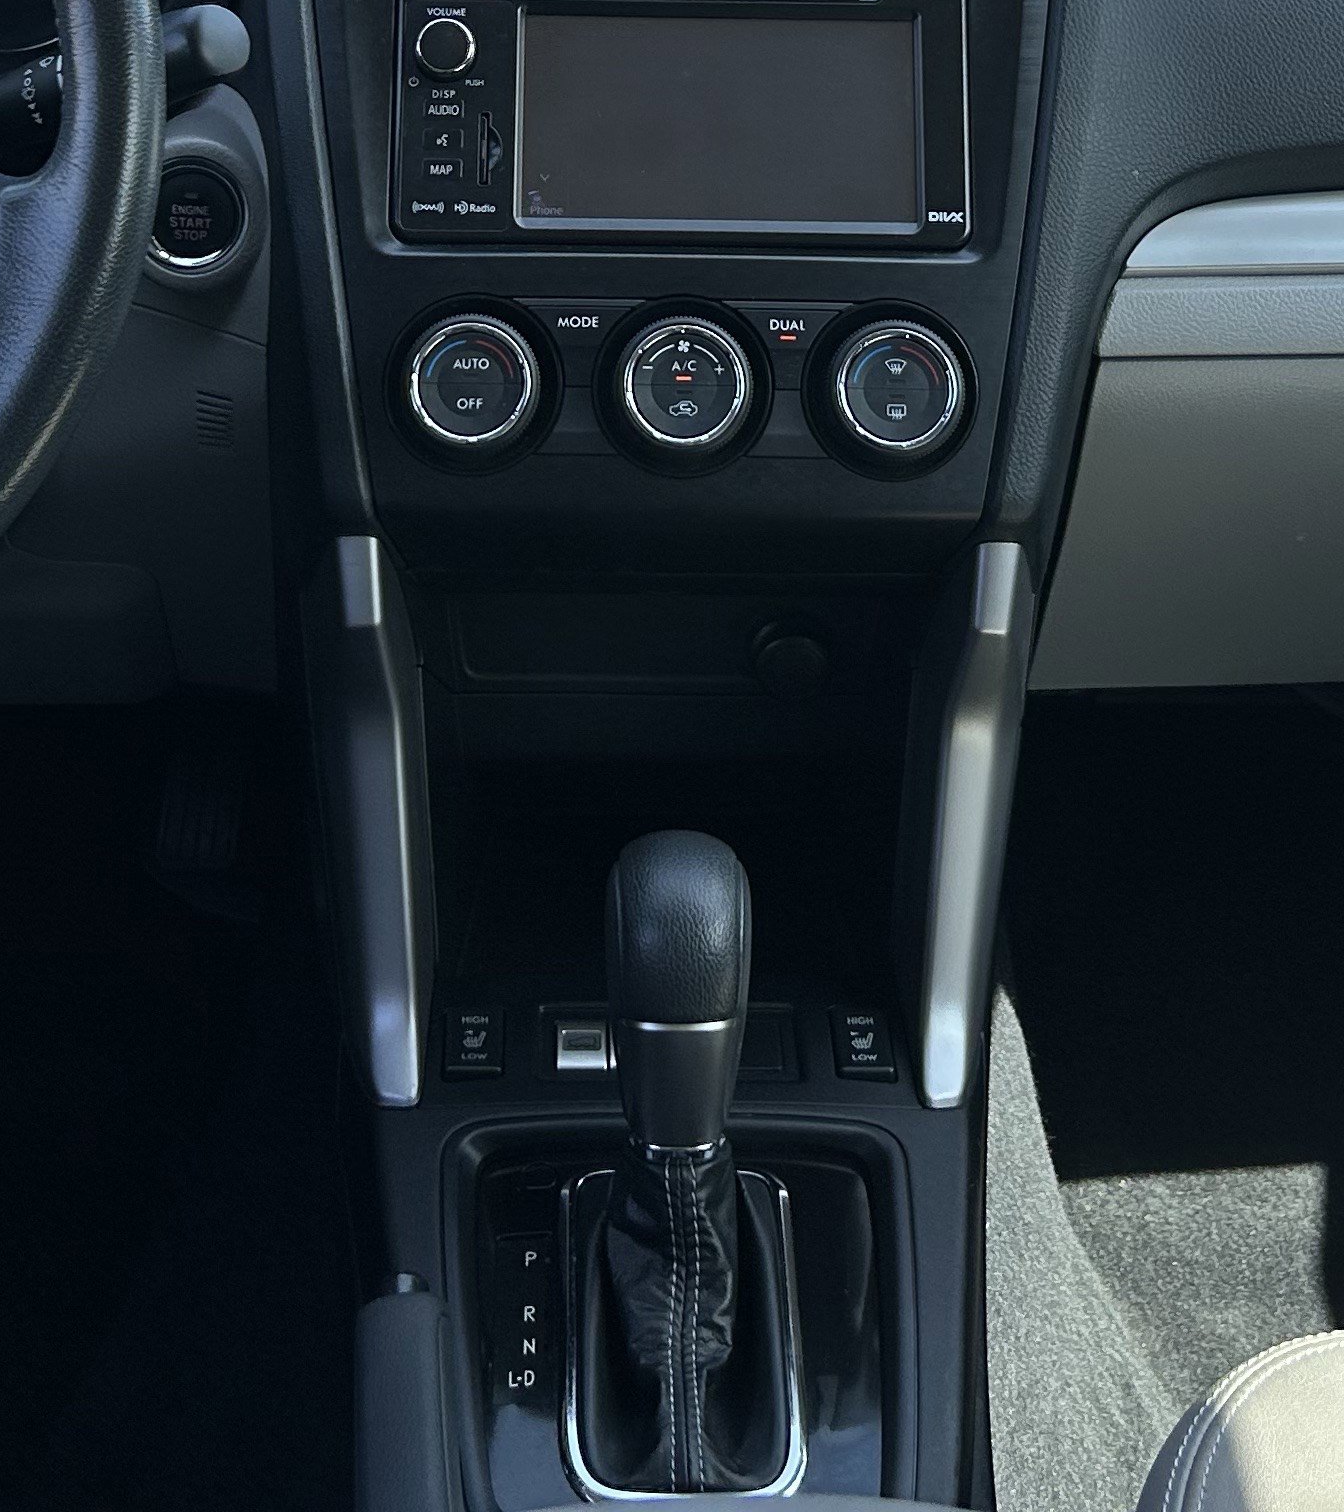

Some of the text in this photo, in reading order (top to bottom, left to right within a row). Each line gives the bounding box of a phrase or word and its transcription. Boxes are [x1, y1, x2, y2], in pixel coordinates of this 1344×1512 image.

[426, 7, 467, 17] VOLUME
[465, 79, 485, 87] PUSH
[431, 89, 456, 99] DISP
[428, 104, 460, 116] AUDIO
[429, 164, 453, 175] MAP
[171, 204, 210, 216] ENGINE
[469, 204, 496, 214] Radio
[529, 205, 564, 215] Phone
[169, 216, 213, 229] START
[174, 229, 208, 241] STOP
[557, 315, 600, 328] MODE
[769, 319, 806, 332] DUAL
[453, 358, 490, 370] AUTO
[671, 359, 698, 373] A/C
[456, 397, 484, 411] OFF
[461, 1015, 489, 1025] HIGH
[846, 1016, 874, 1026] HIGH
[461, 1052, 488, 1060] LOW
[851, 1053, 878, 1061] LOW
[525, 1251, 537, 1267] P
[523, 1305, 536, 1322] R
[522, 1338, 536, 1355] N
